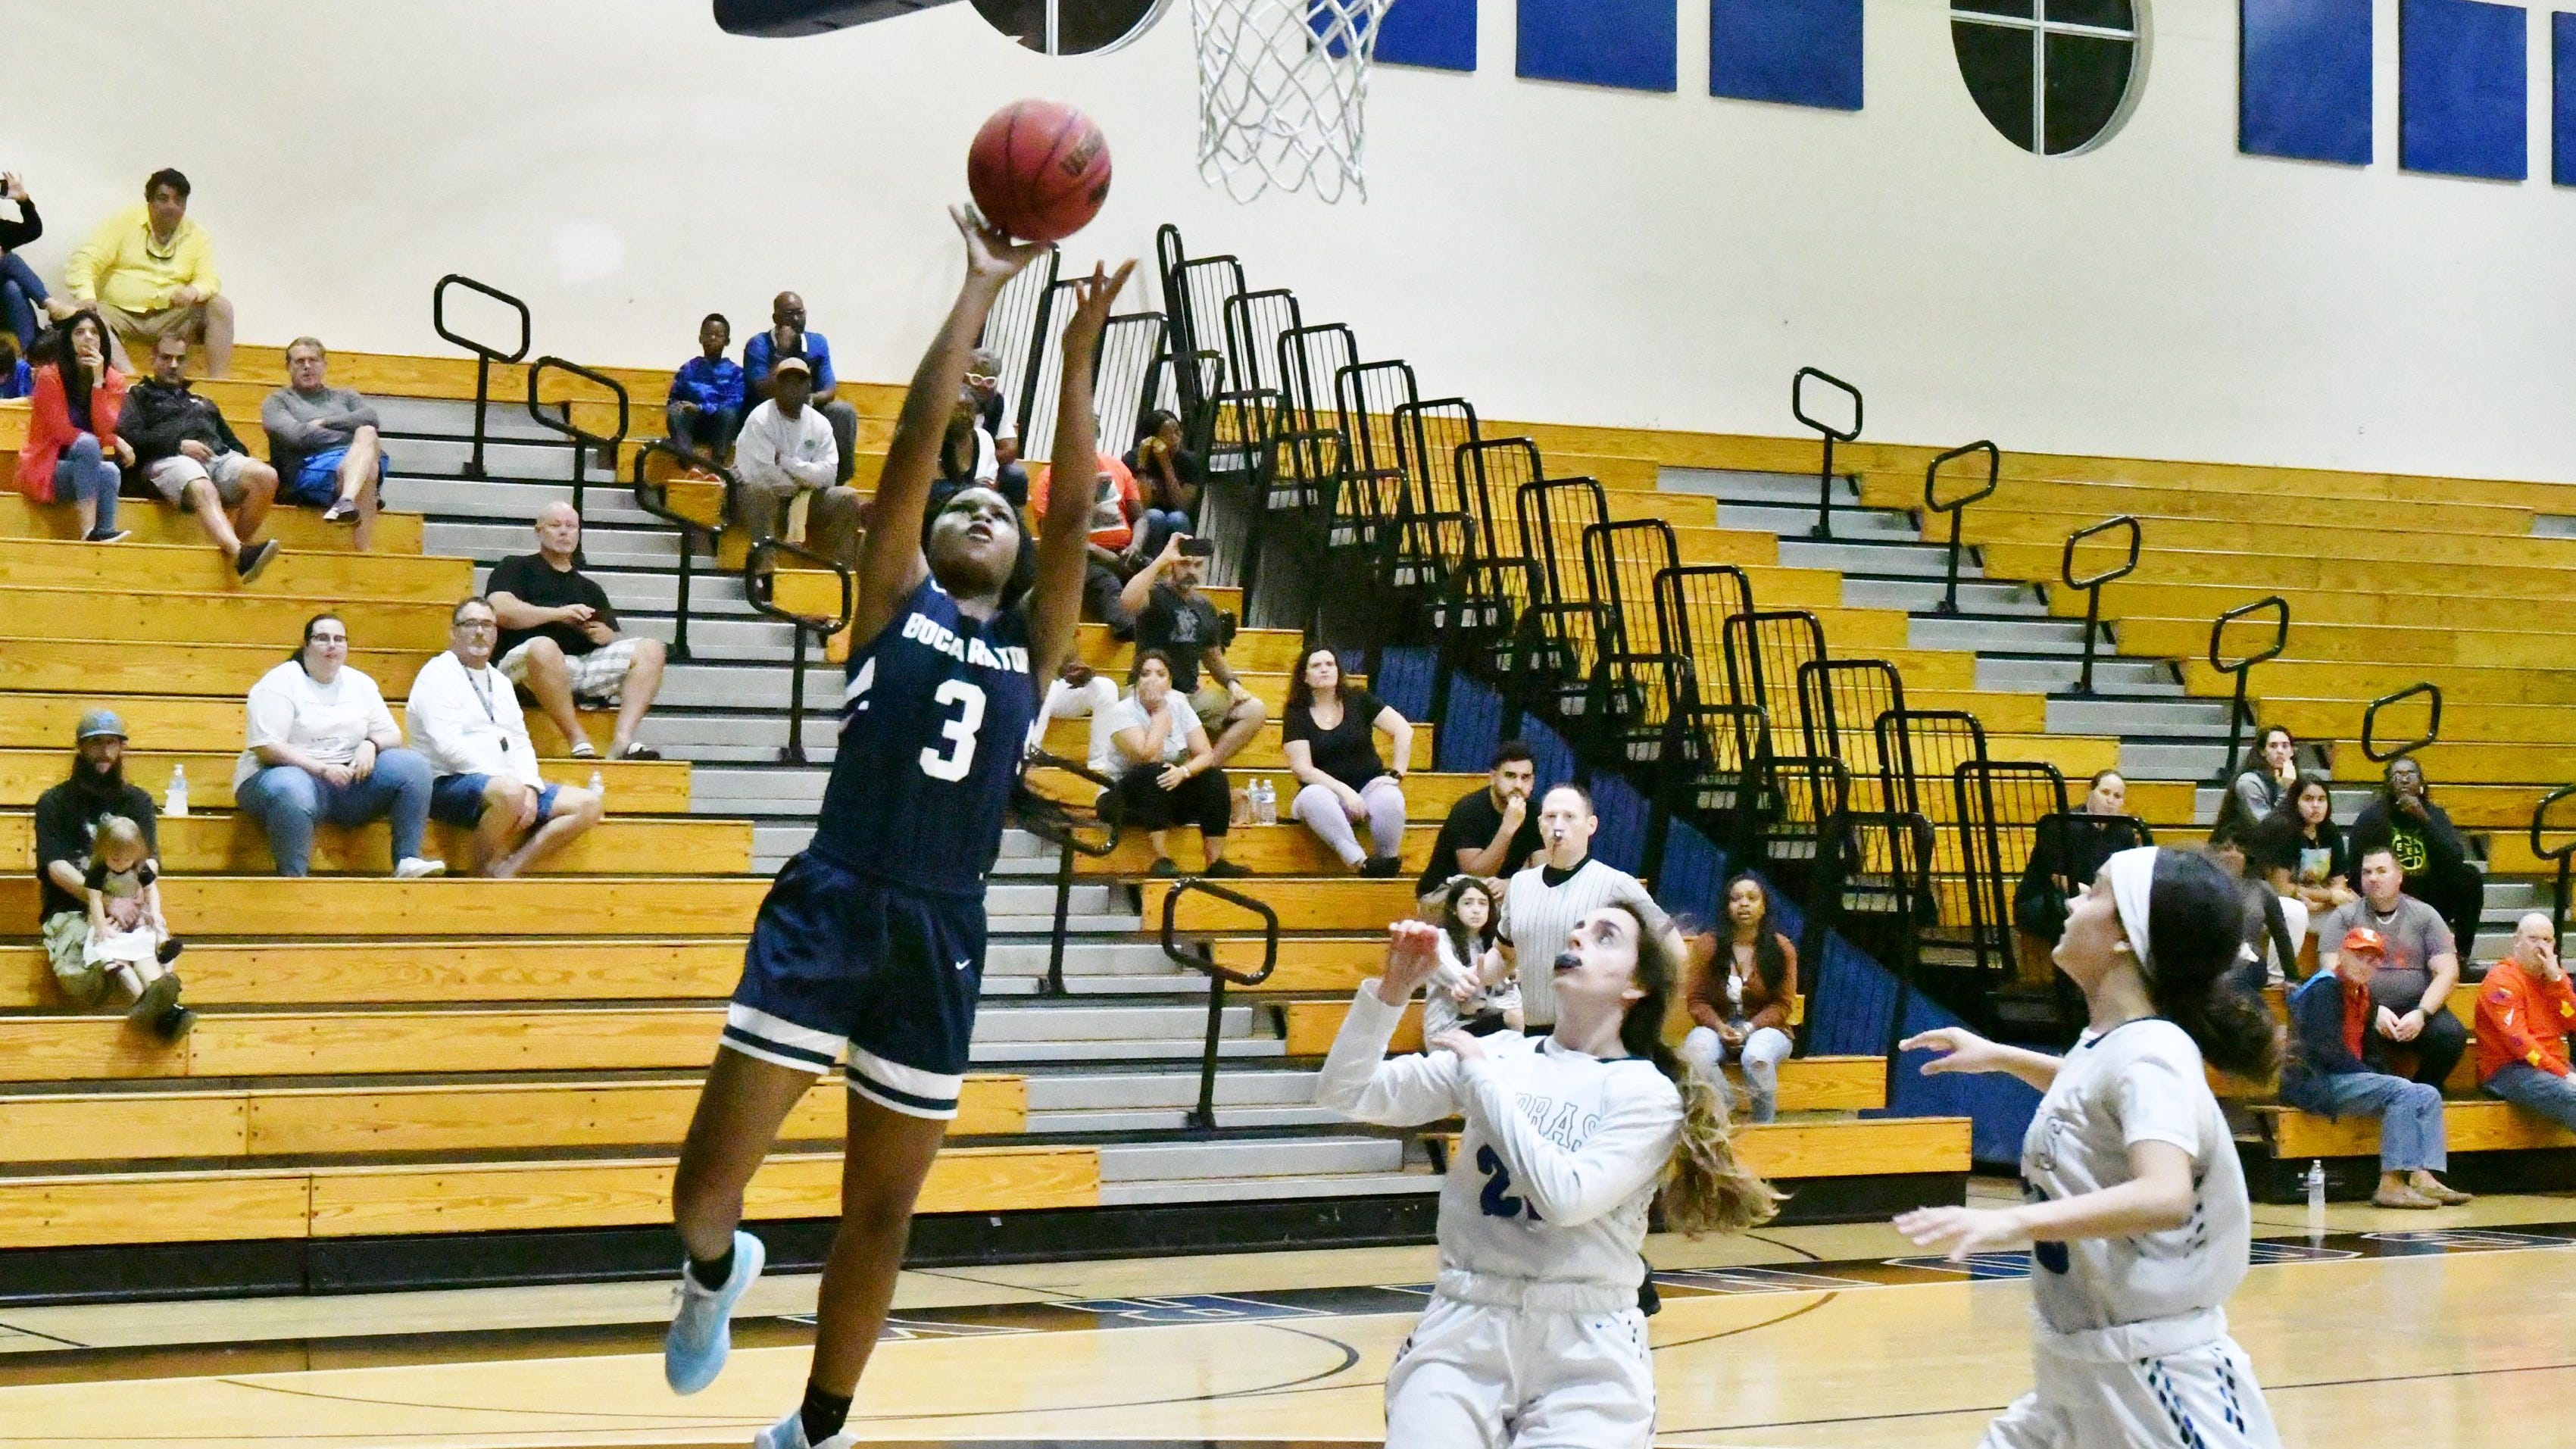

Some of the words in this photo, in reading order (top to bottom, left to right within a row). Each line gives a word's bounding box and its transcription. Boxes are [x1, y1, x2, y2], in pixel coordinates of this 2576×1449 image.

[902, 612, 964, 662] BOCA
[967, 637, 1030, 673] RATO
[920, 679, 987, 782] 3
